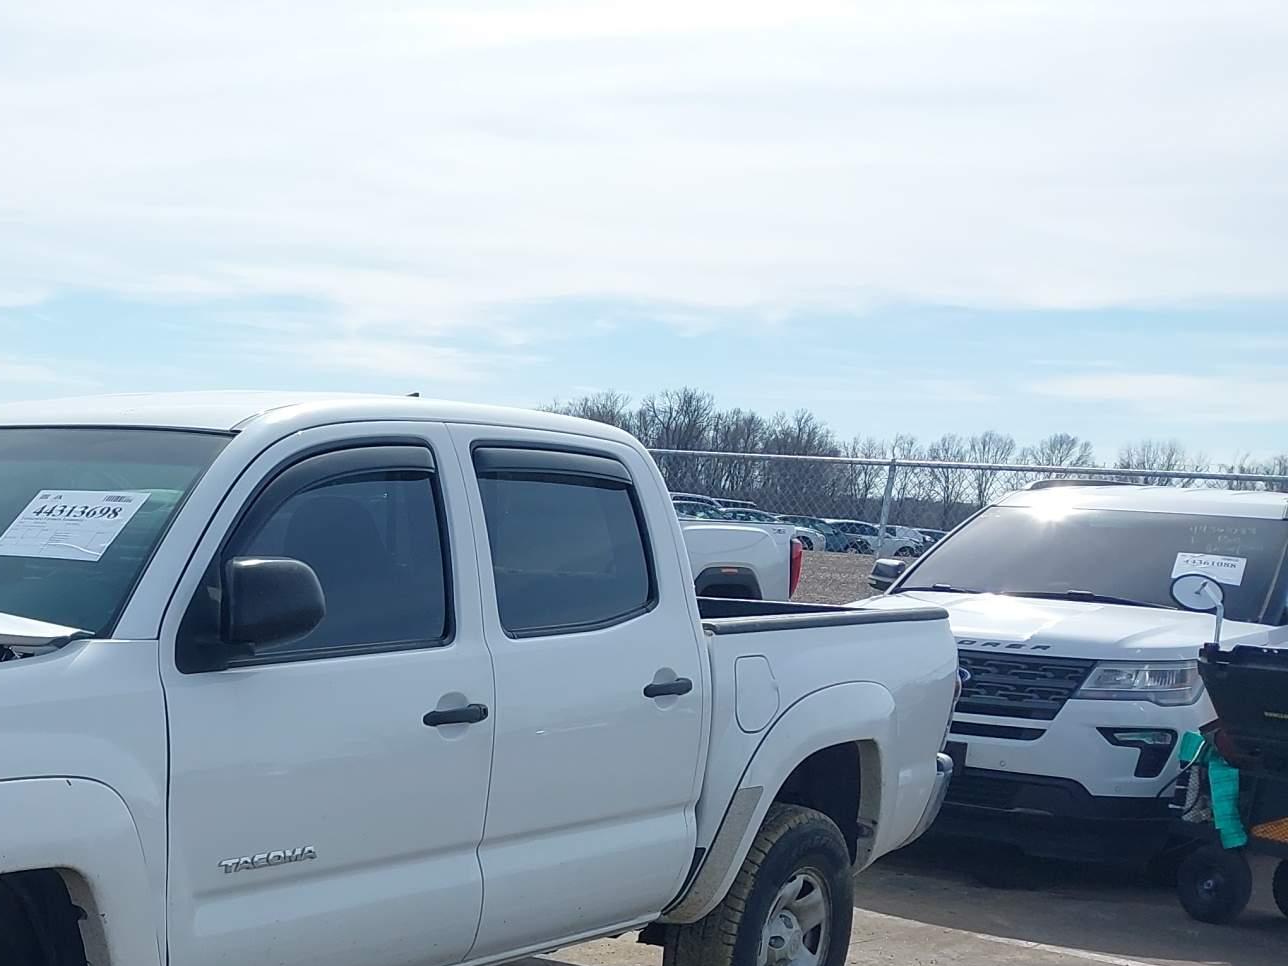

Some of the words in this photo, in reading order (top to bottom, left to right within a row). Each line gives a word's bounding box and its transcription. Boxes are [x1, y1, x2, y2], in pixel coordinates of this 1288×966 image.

[32, 503, 123, 520] 44313698
[956, 640, 1052, 651] ORER
[218, 845, 318, 874] TACOMA
